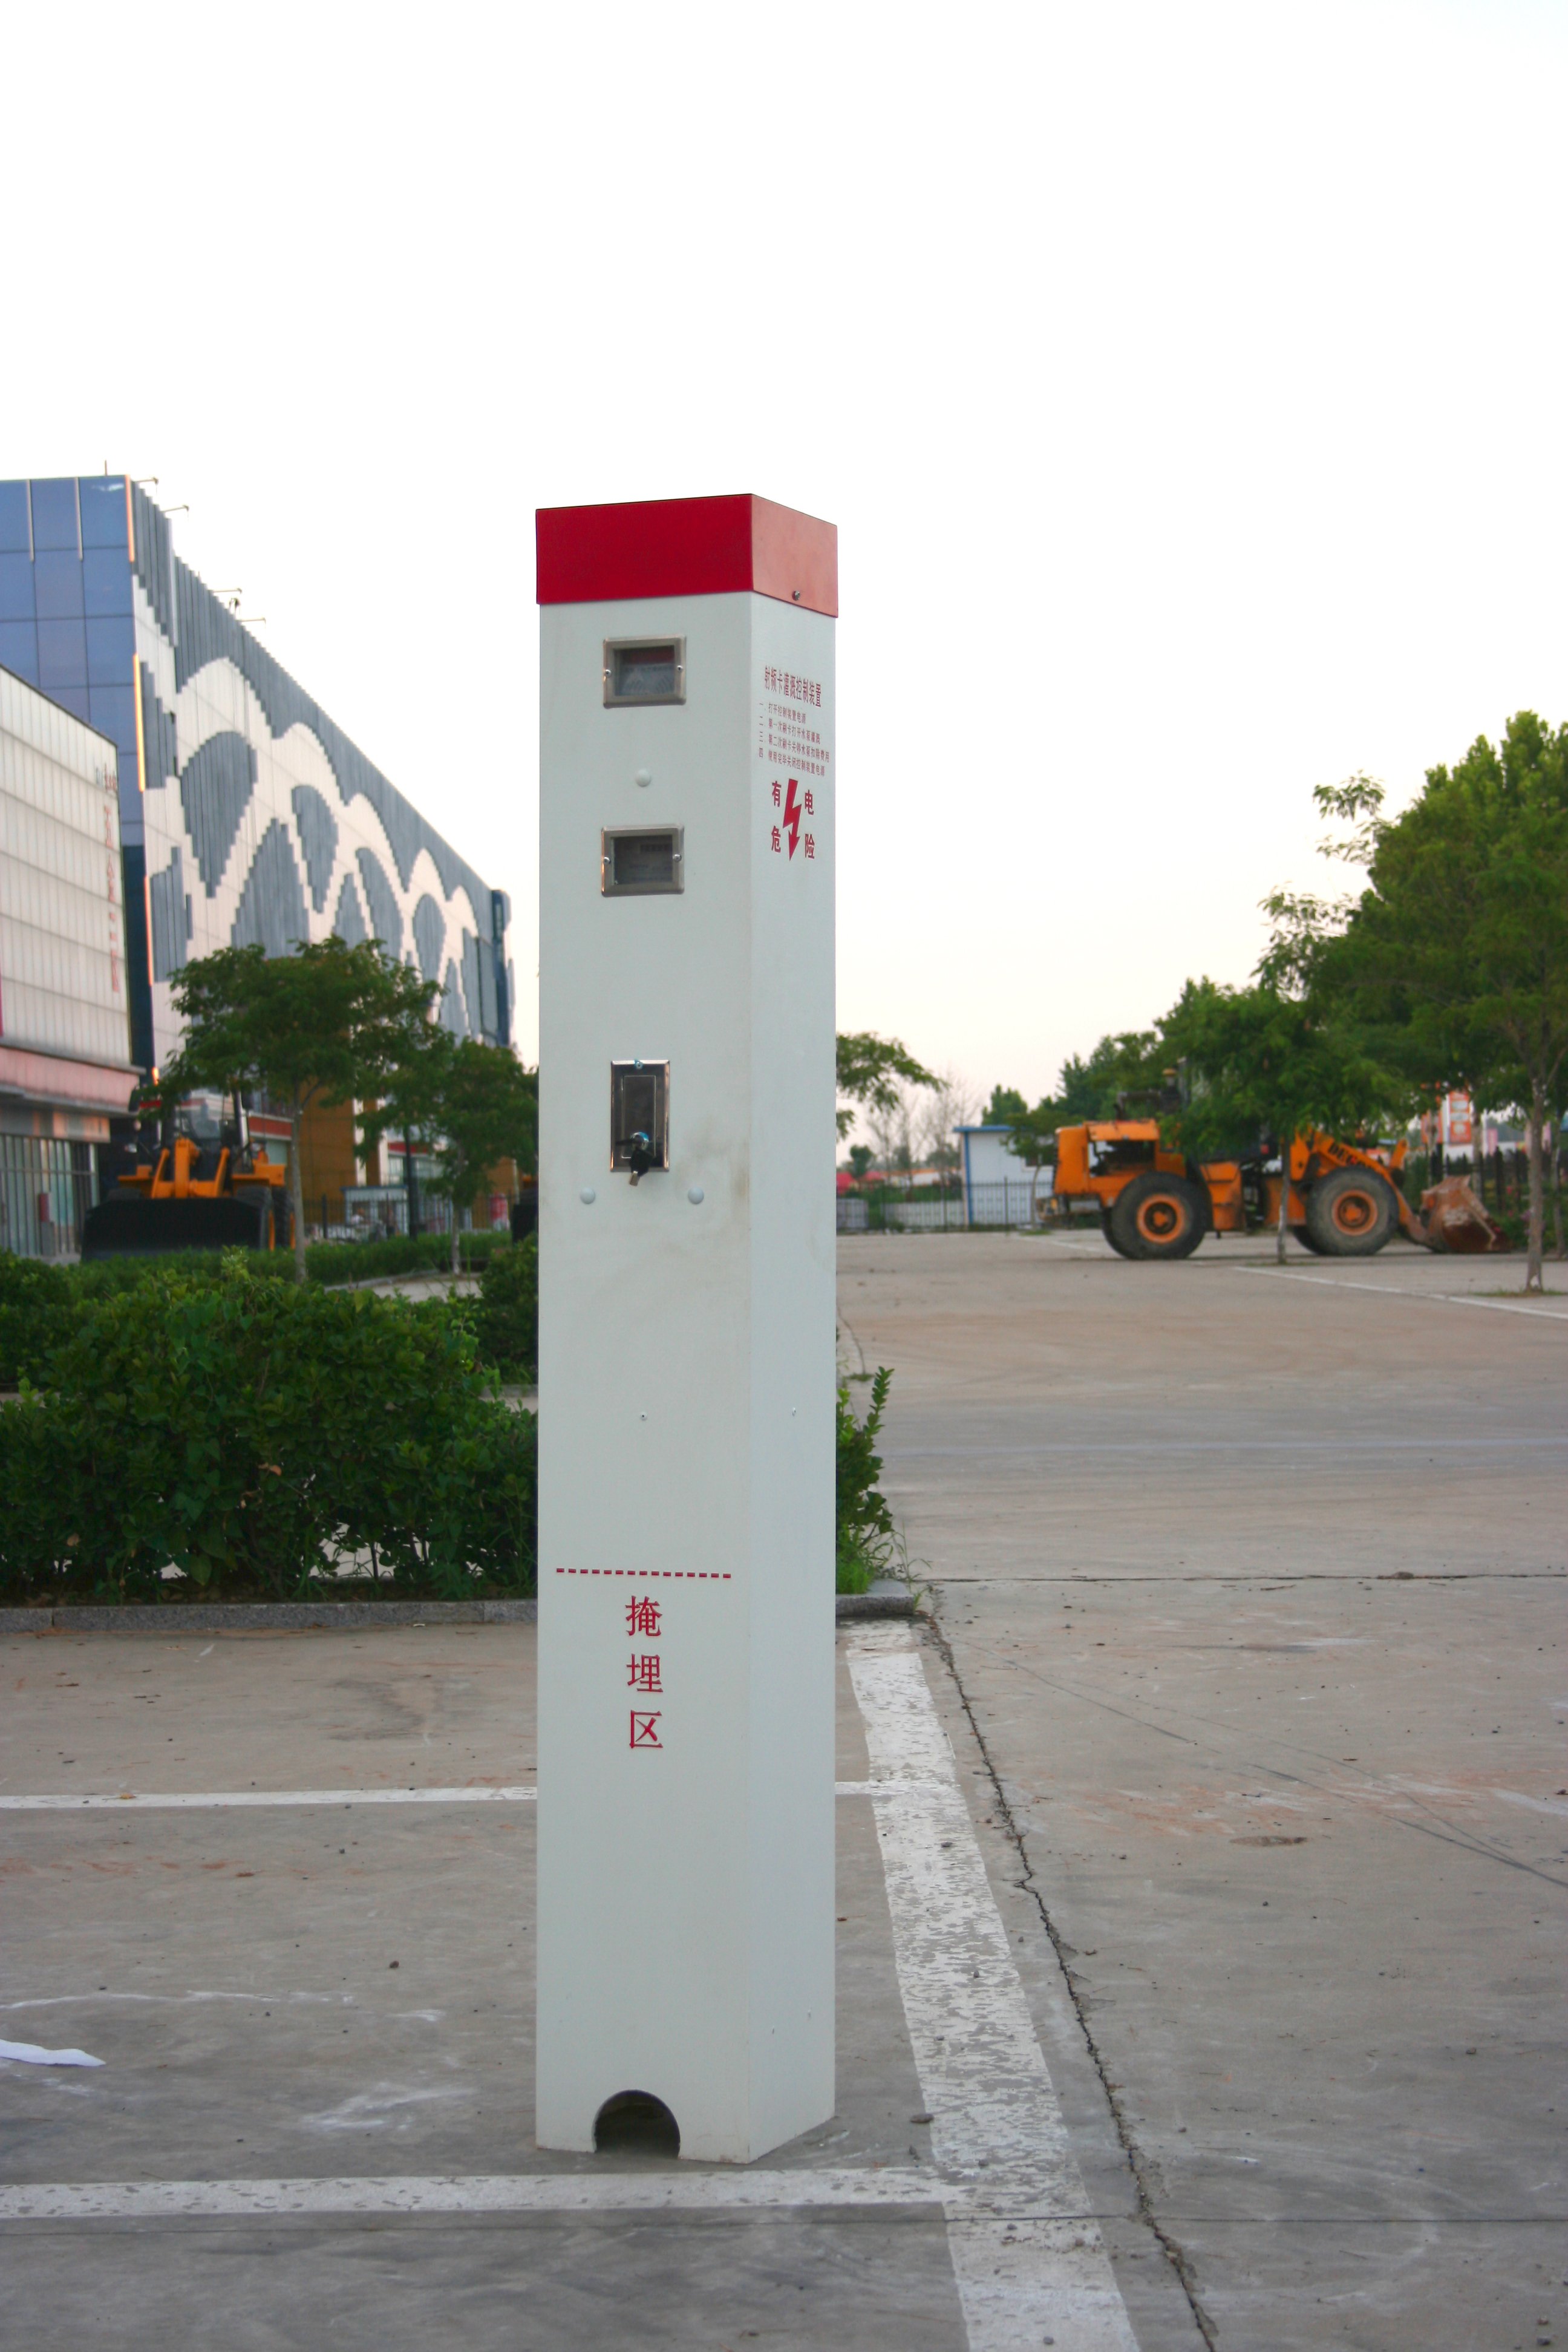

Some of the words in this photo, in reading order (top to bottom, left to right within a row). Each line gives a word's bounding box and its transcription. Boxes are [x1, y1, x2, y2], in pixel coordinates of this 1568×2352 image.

[765, 665, 821, 707] 射频卡灌溉控制装置
[625, 1595, 664, 1749] 掩埋区
